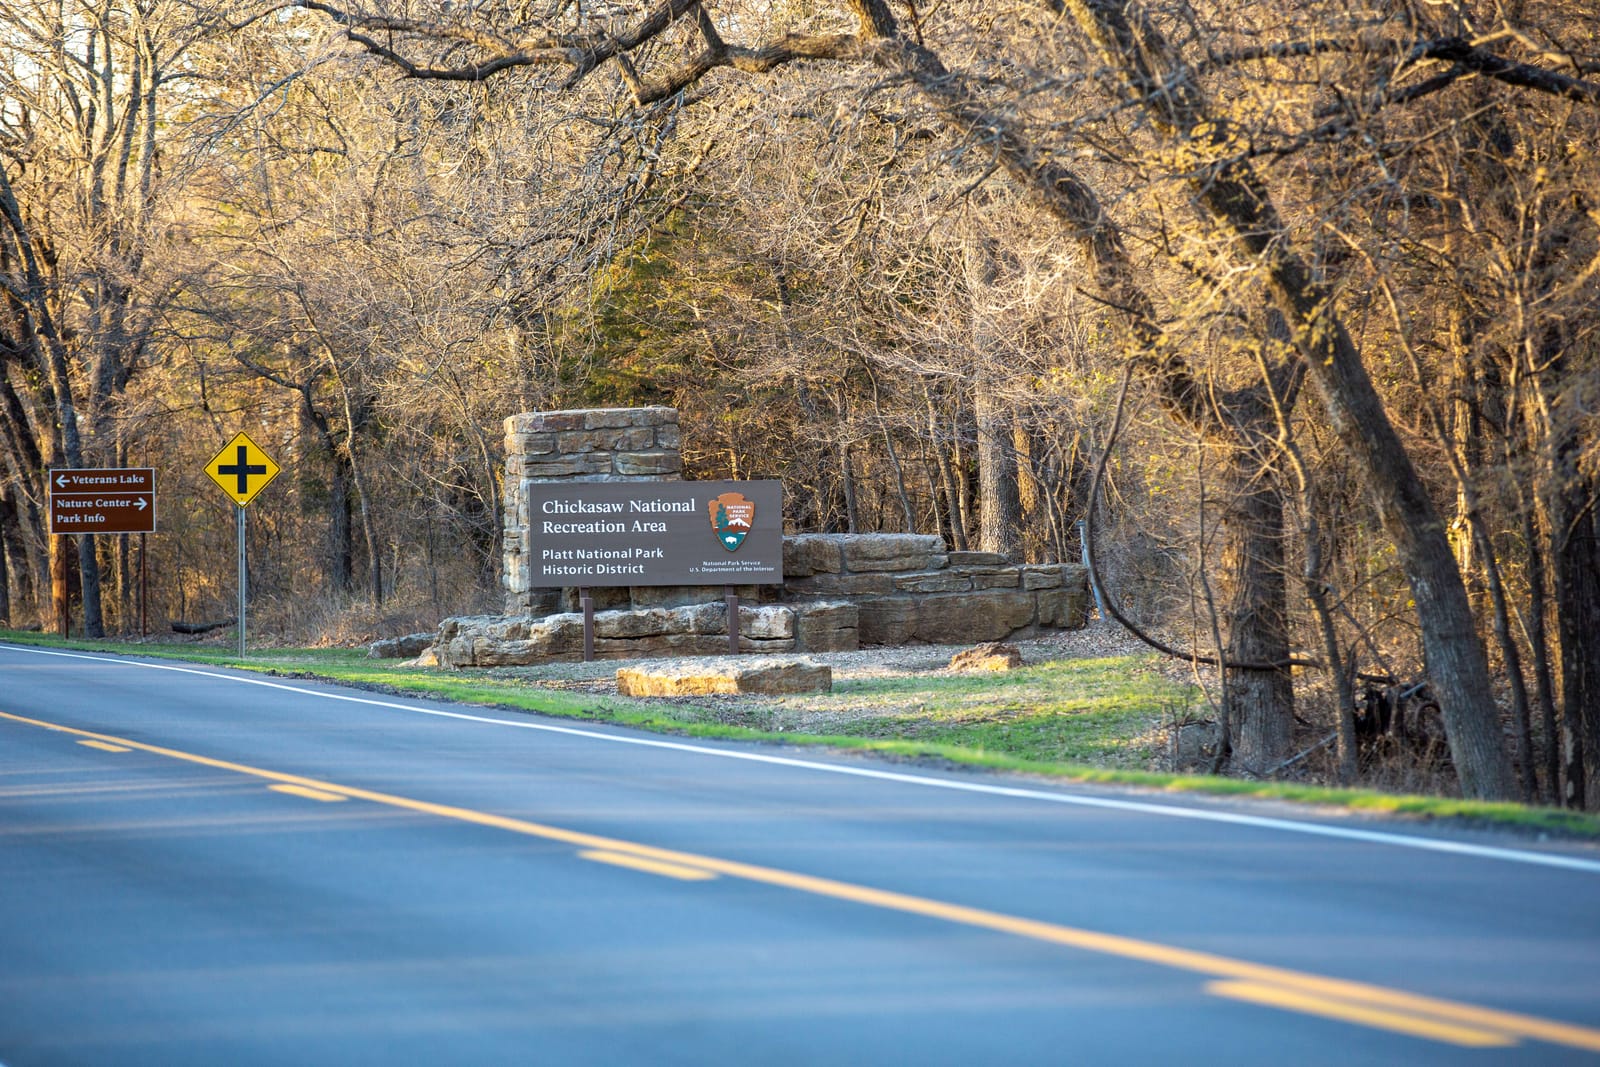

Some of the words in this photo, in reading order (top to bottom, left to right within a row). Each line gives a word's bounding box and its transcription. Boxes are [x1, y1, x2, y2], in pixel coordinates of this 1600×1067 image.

[72, 475, 117, 484] Veterans
[120, 474, 144, 483] Lake
[57, 500, 93, 508] Nature
[96, 499, 131, 507] Center
[542, 500, 624, 514] Chickasaw
[630, 498, 696, 513] National
[57, 514, 81, 523] Park
[84, 514, 105, 522] Info
[542, 520, 625, 534] Recreation
[632, 520, 666, 532] Area
[542, 549, 573, 560] Platt
[576, 548, 632, 559] National
[635, 547, 664, 558] Park
[543, 564, 593, 575] Historic
[596, 564, 644, 574] District
